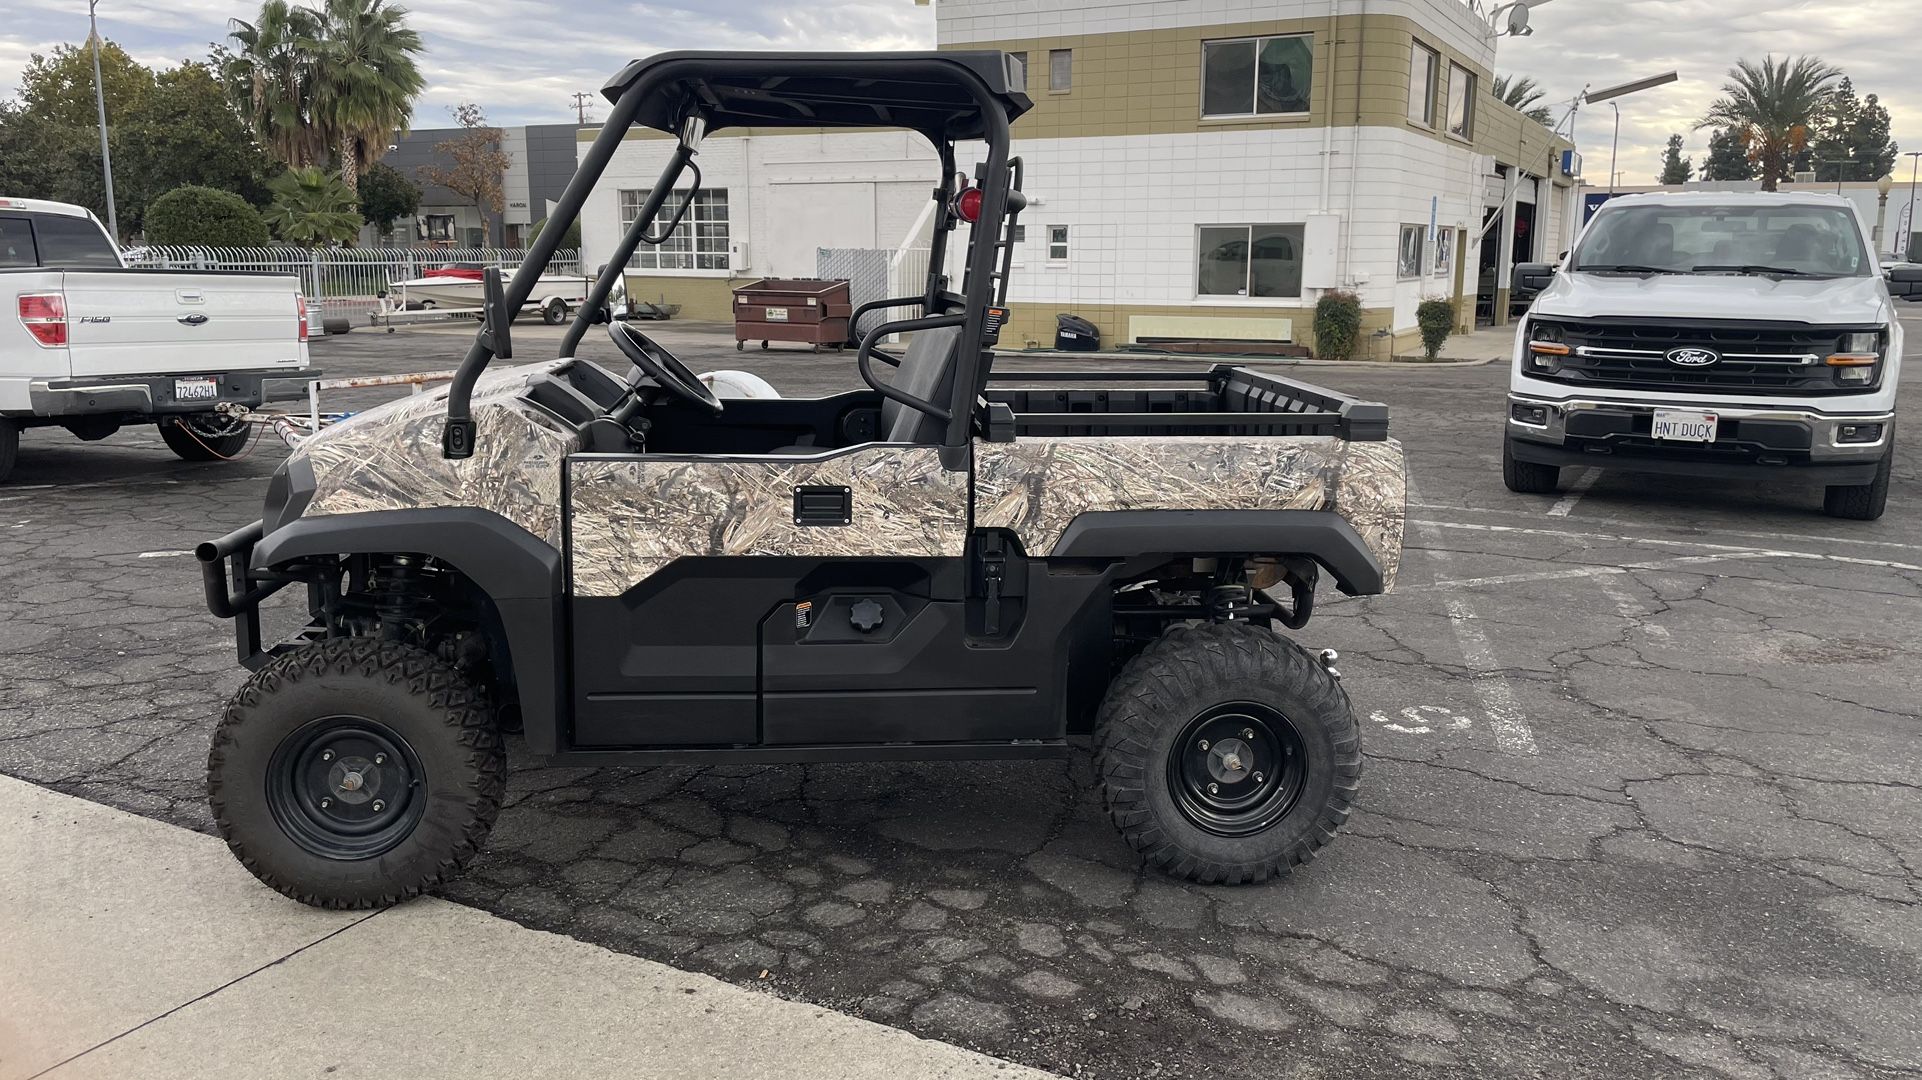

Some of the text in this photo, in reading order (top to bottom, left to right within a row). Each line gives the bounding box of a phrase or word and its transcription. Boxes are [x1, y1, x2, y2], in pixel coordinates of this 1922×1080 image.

[1676, 350, 1708, 363] Ford
[1655, 421, 1713, 438] HNT DUCK
